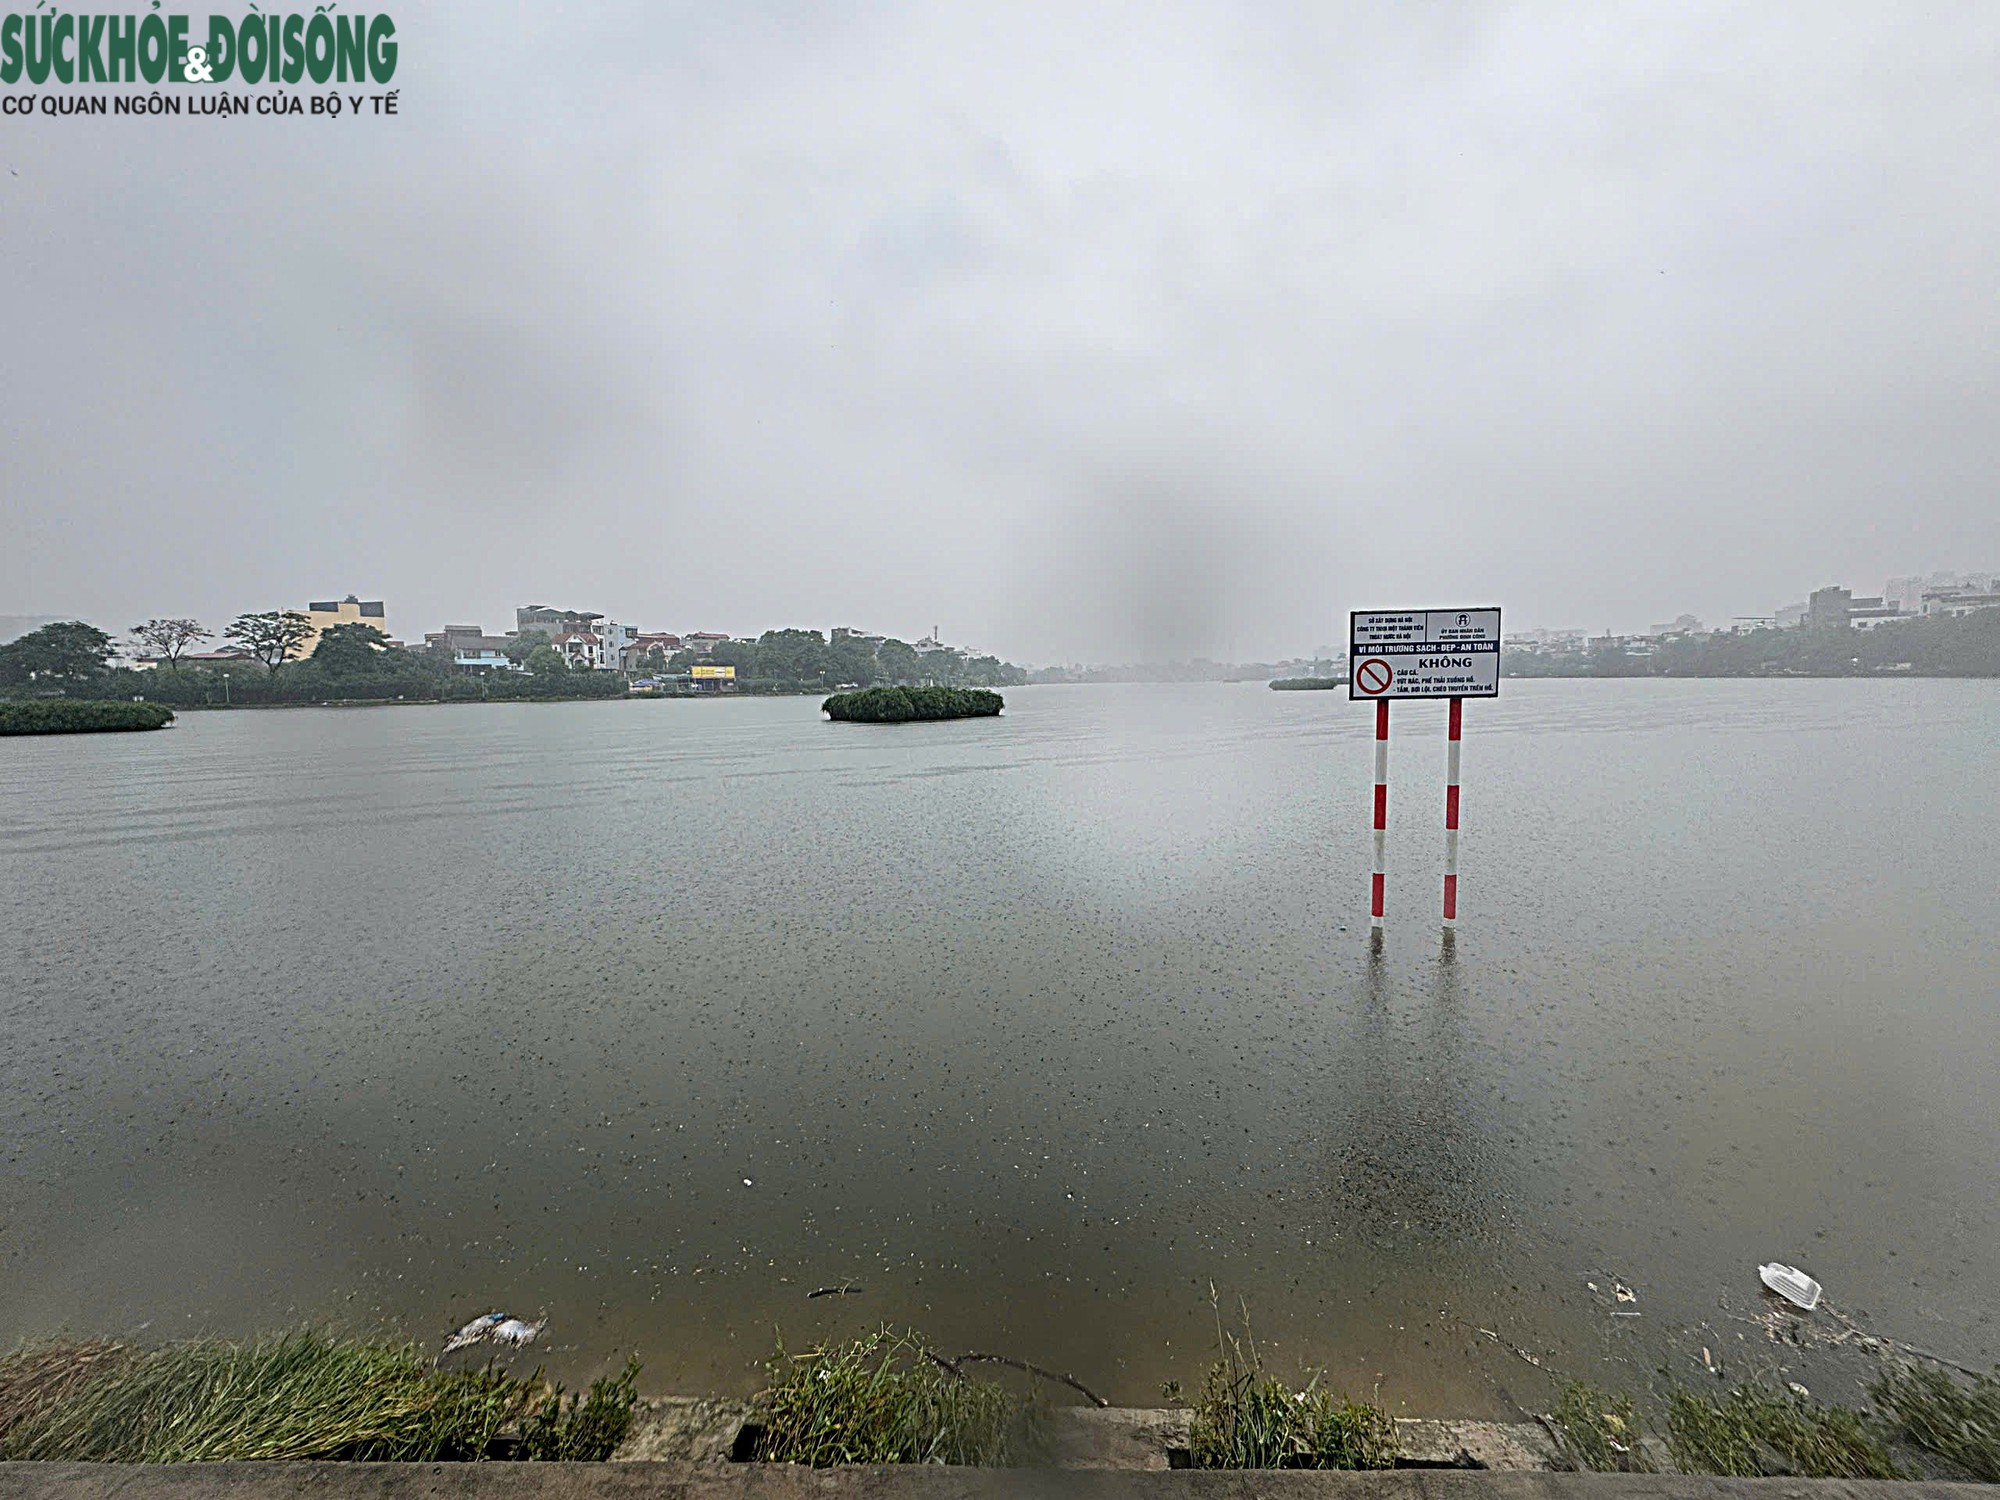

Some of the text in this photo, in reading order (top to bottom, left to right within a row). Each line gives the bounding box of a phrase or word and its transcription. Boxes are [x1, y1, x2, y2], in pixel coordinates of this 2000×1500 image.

[1368, 644, 1383, 653] MÔI
[1416, 644, 1436, 654] SẠCH
[1418, 656, 1472, 668] KHÔNG
